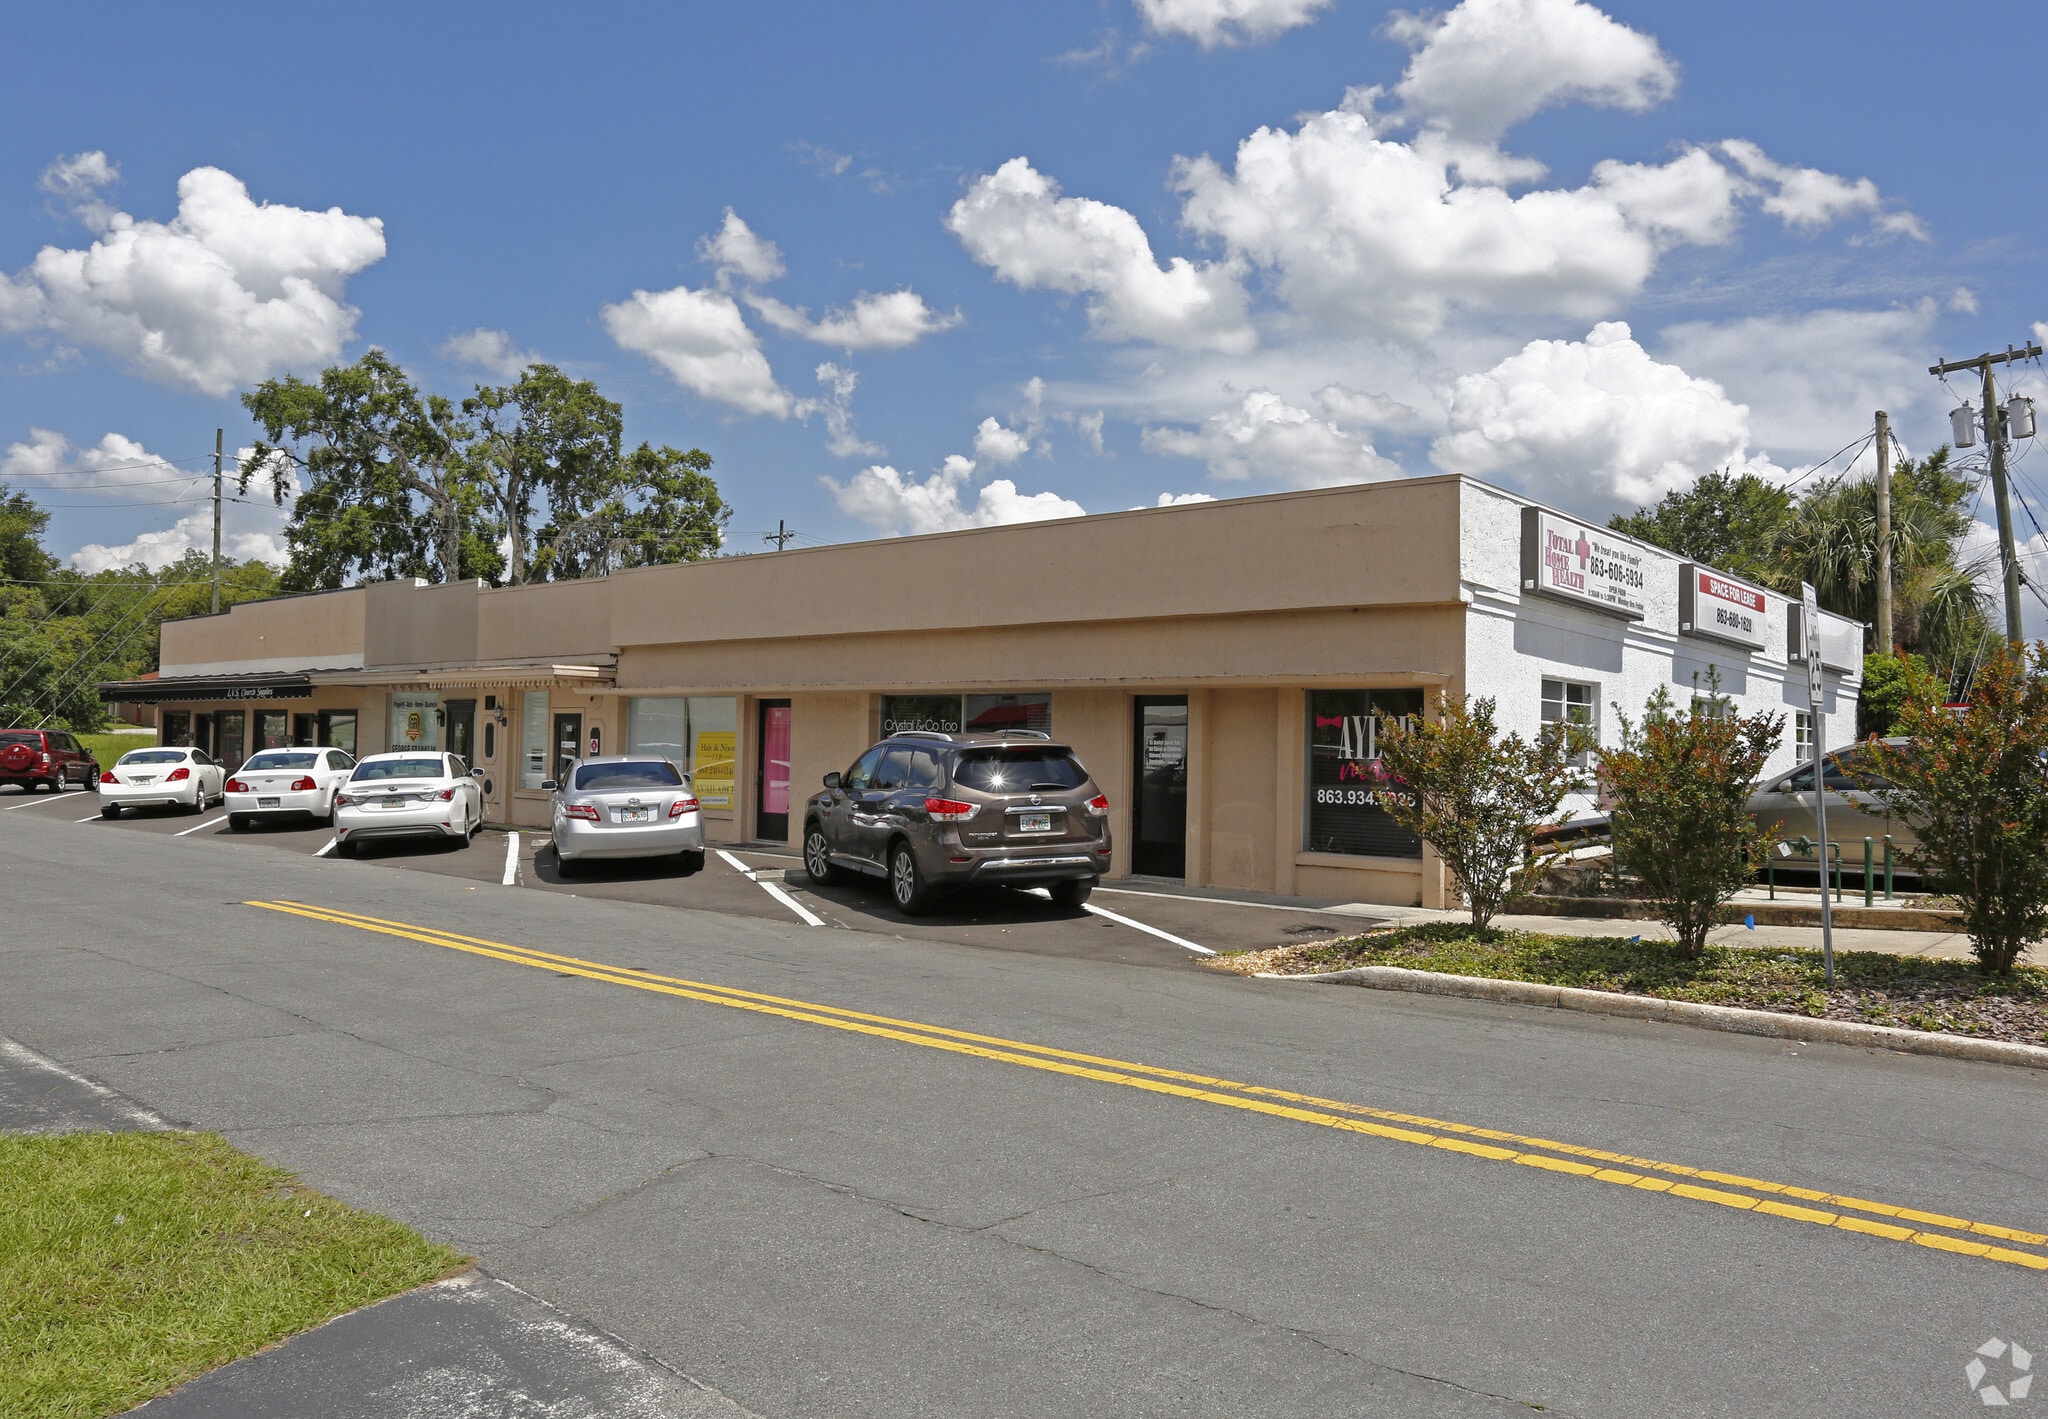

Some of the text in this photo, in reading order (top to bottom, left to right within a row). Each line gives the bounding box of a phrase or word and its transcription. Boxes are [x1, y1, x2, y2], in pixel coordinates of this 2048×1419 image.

[1546, 528, 1574, 554] TOTAL
[1601, 545, 1611, 557] treat
[1545, 546, 1569, 570] HOME
[1552, 567, 1584, 589] HEALTH
[1590, 556, 1643, 589] 863-606-5934
[1710, 580, 1756, 608] SPACE FOR LEASE
[1810, 649, 1822, 692] 25
[885, 719, 958, 732] Crystal & Co Too
